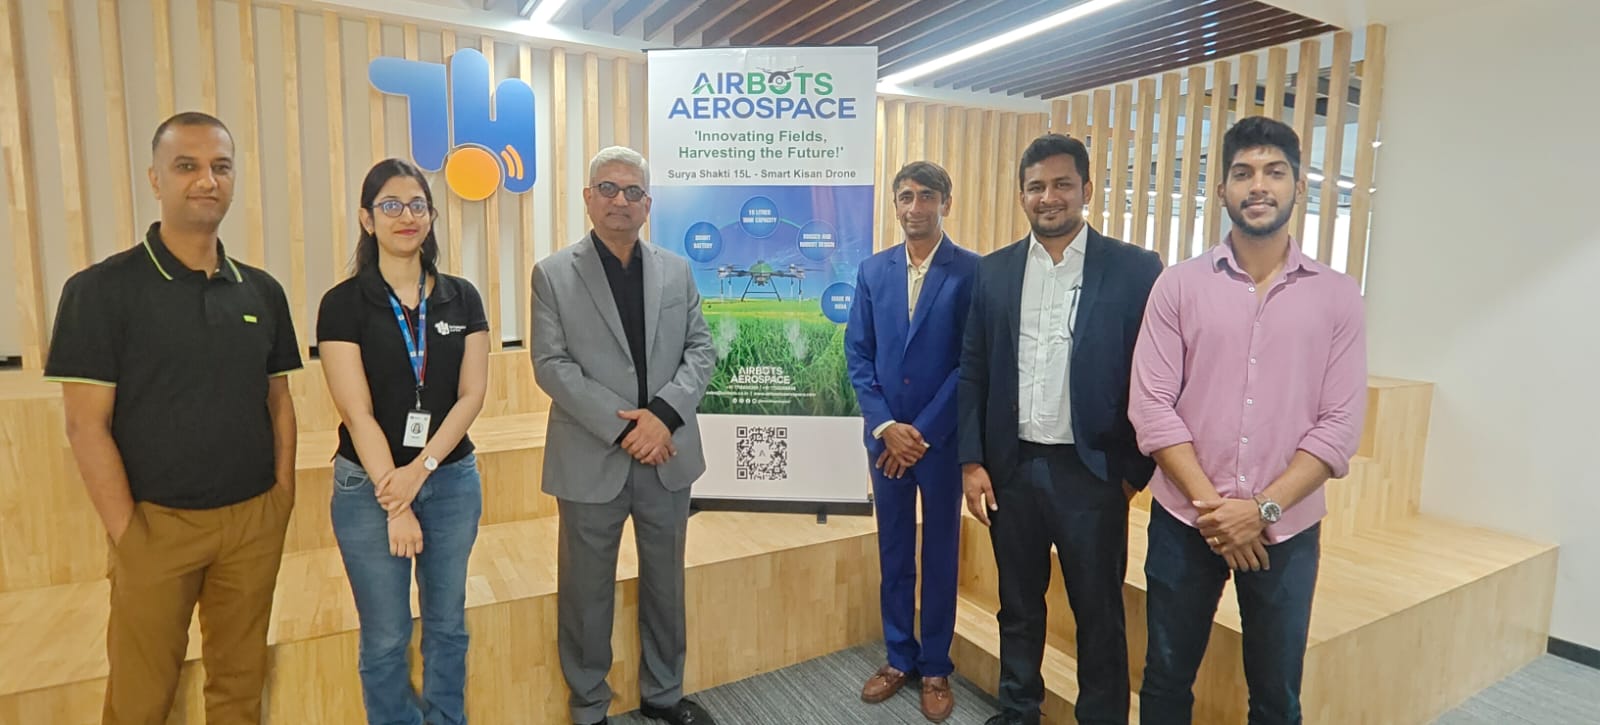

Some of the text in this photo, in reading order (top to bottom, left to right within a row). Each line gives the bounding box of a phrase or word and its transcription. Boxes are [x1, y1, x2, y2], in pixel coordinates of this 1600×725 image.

[691, 71, 833, 95] AIRBOTS
[668, 97, 856, 119] AEROSPACE
[779, 130, 828, 144] Fields,
[679, 146, 844, 161] Harvesting the Future!'
[668, 169, 697, 180] Surya
[699, 169, 730, 178] Shakti
[734, 170, 751, 178] 15L
[760, 169, 790, 178] Smart
[793, 169, 822, 178] Kisan
[826, 169, 856, 178] Drone
[738, 366, 783, 375] AIRBOTS
[730, 375, 791, 384] AEROSPACE
